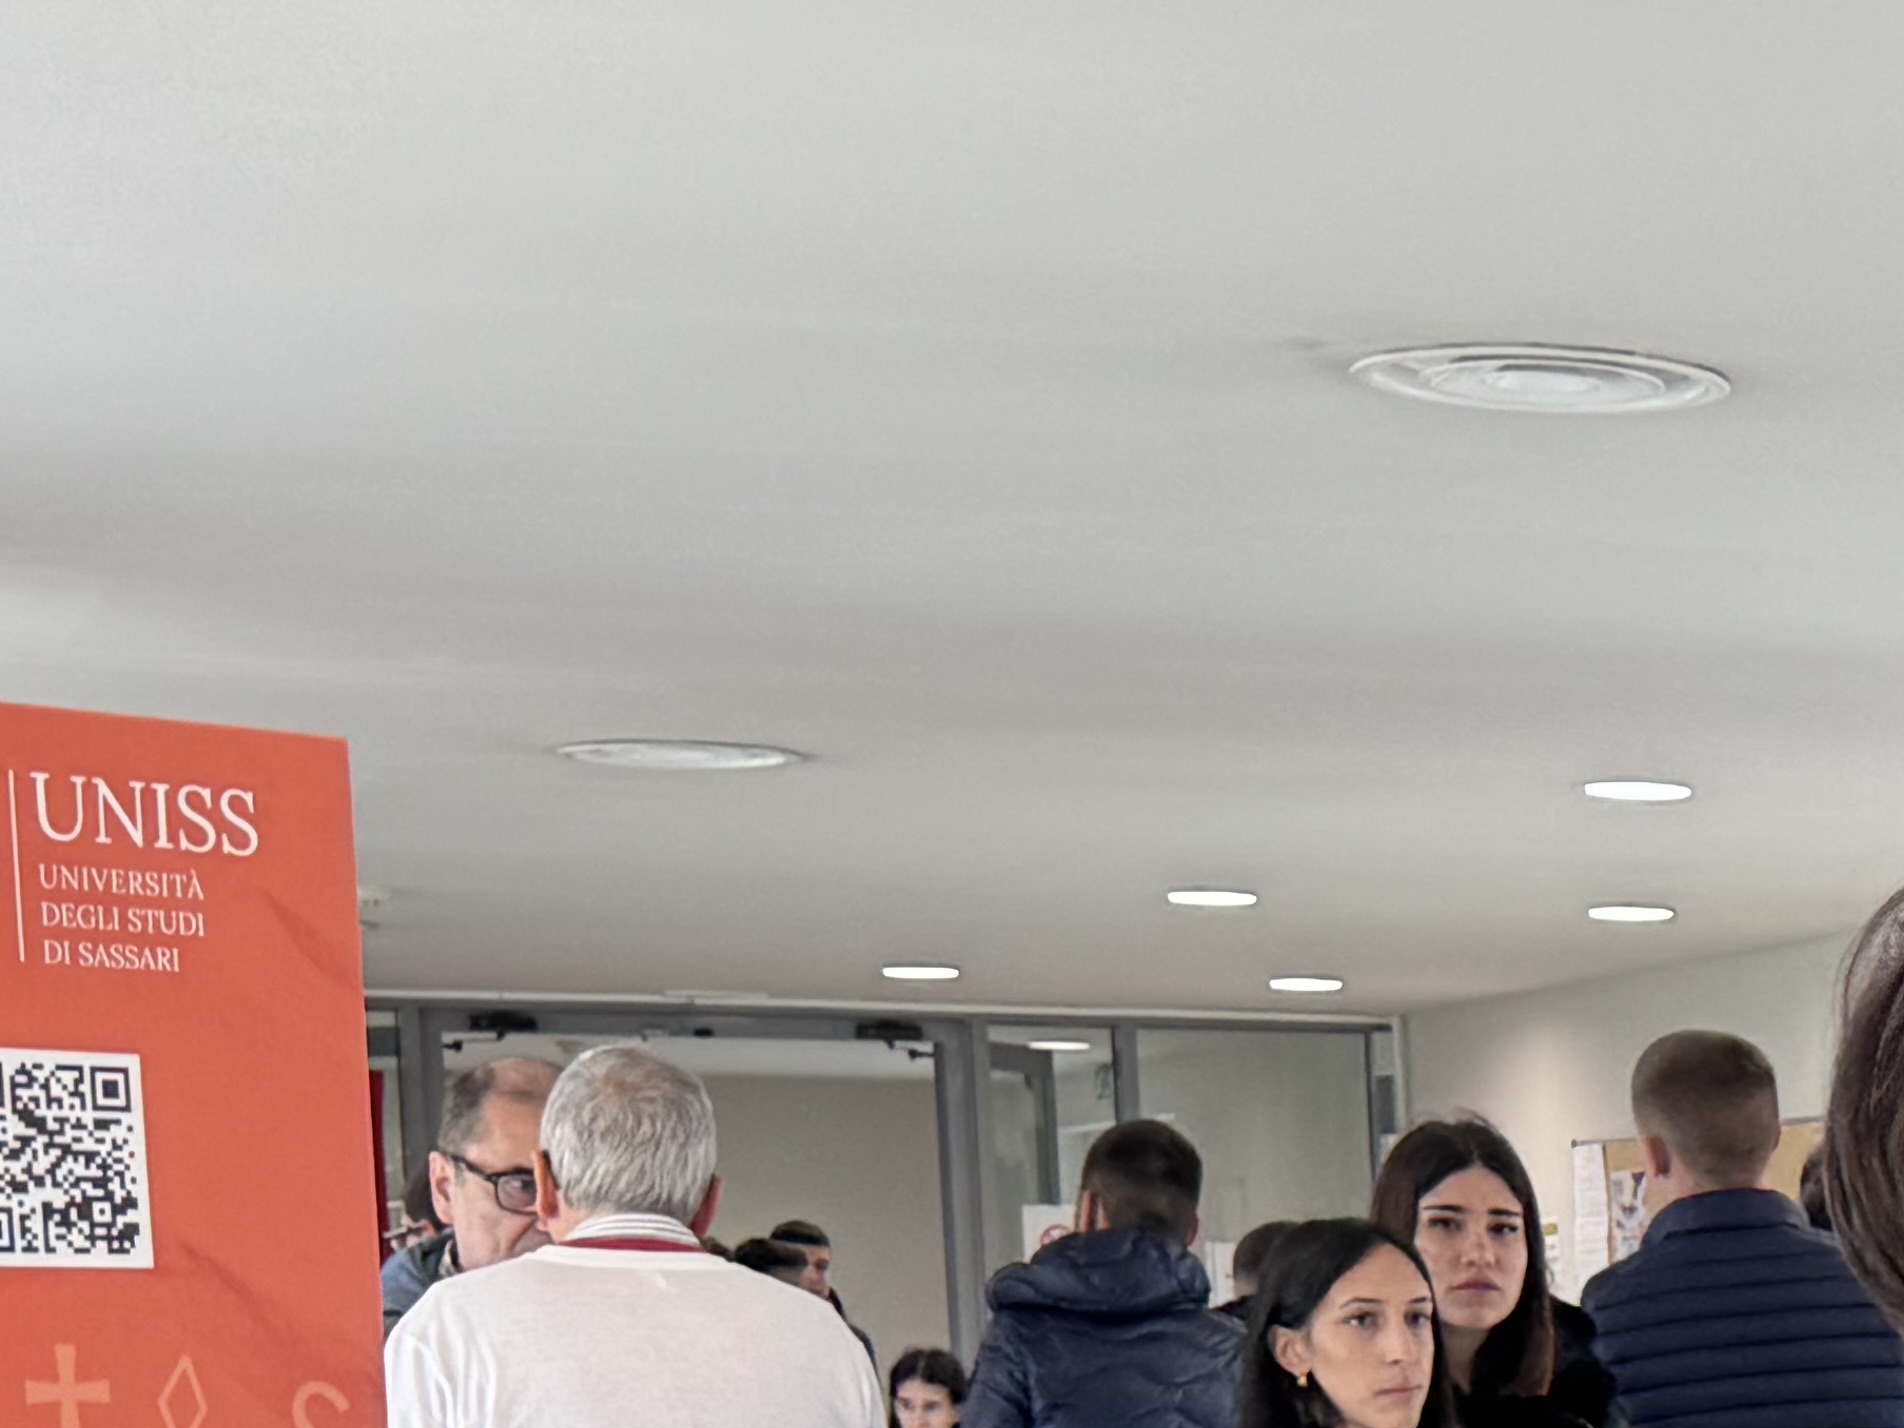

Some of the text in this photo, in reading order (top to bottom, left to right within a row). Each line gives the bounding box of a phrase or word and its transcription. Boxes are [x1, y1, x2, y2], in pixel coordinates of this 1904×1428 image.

[30, 771, 260, 857] UNISS
[38, 863, 205, 901] UNIVERSITÀ
[41, 902, 206, 937] DEGLI STUDI
[43, 940, 181, 973] DI SASSARI
